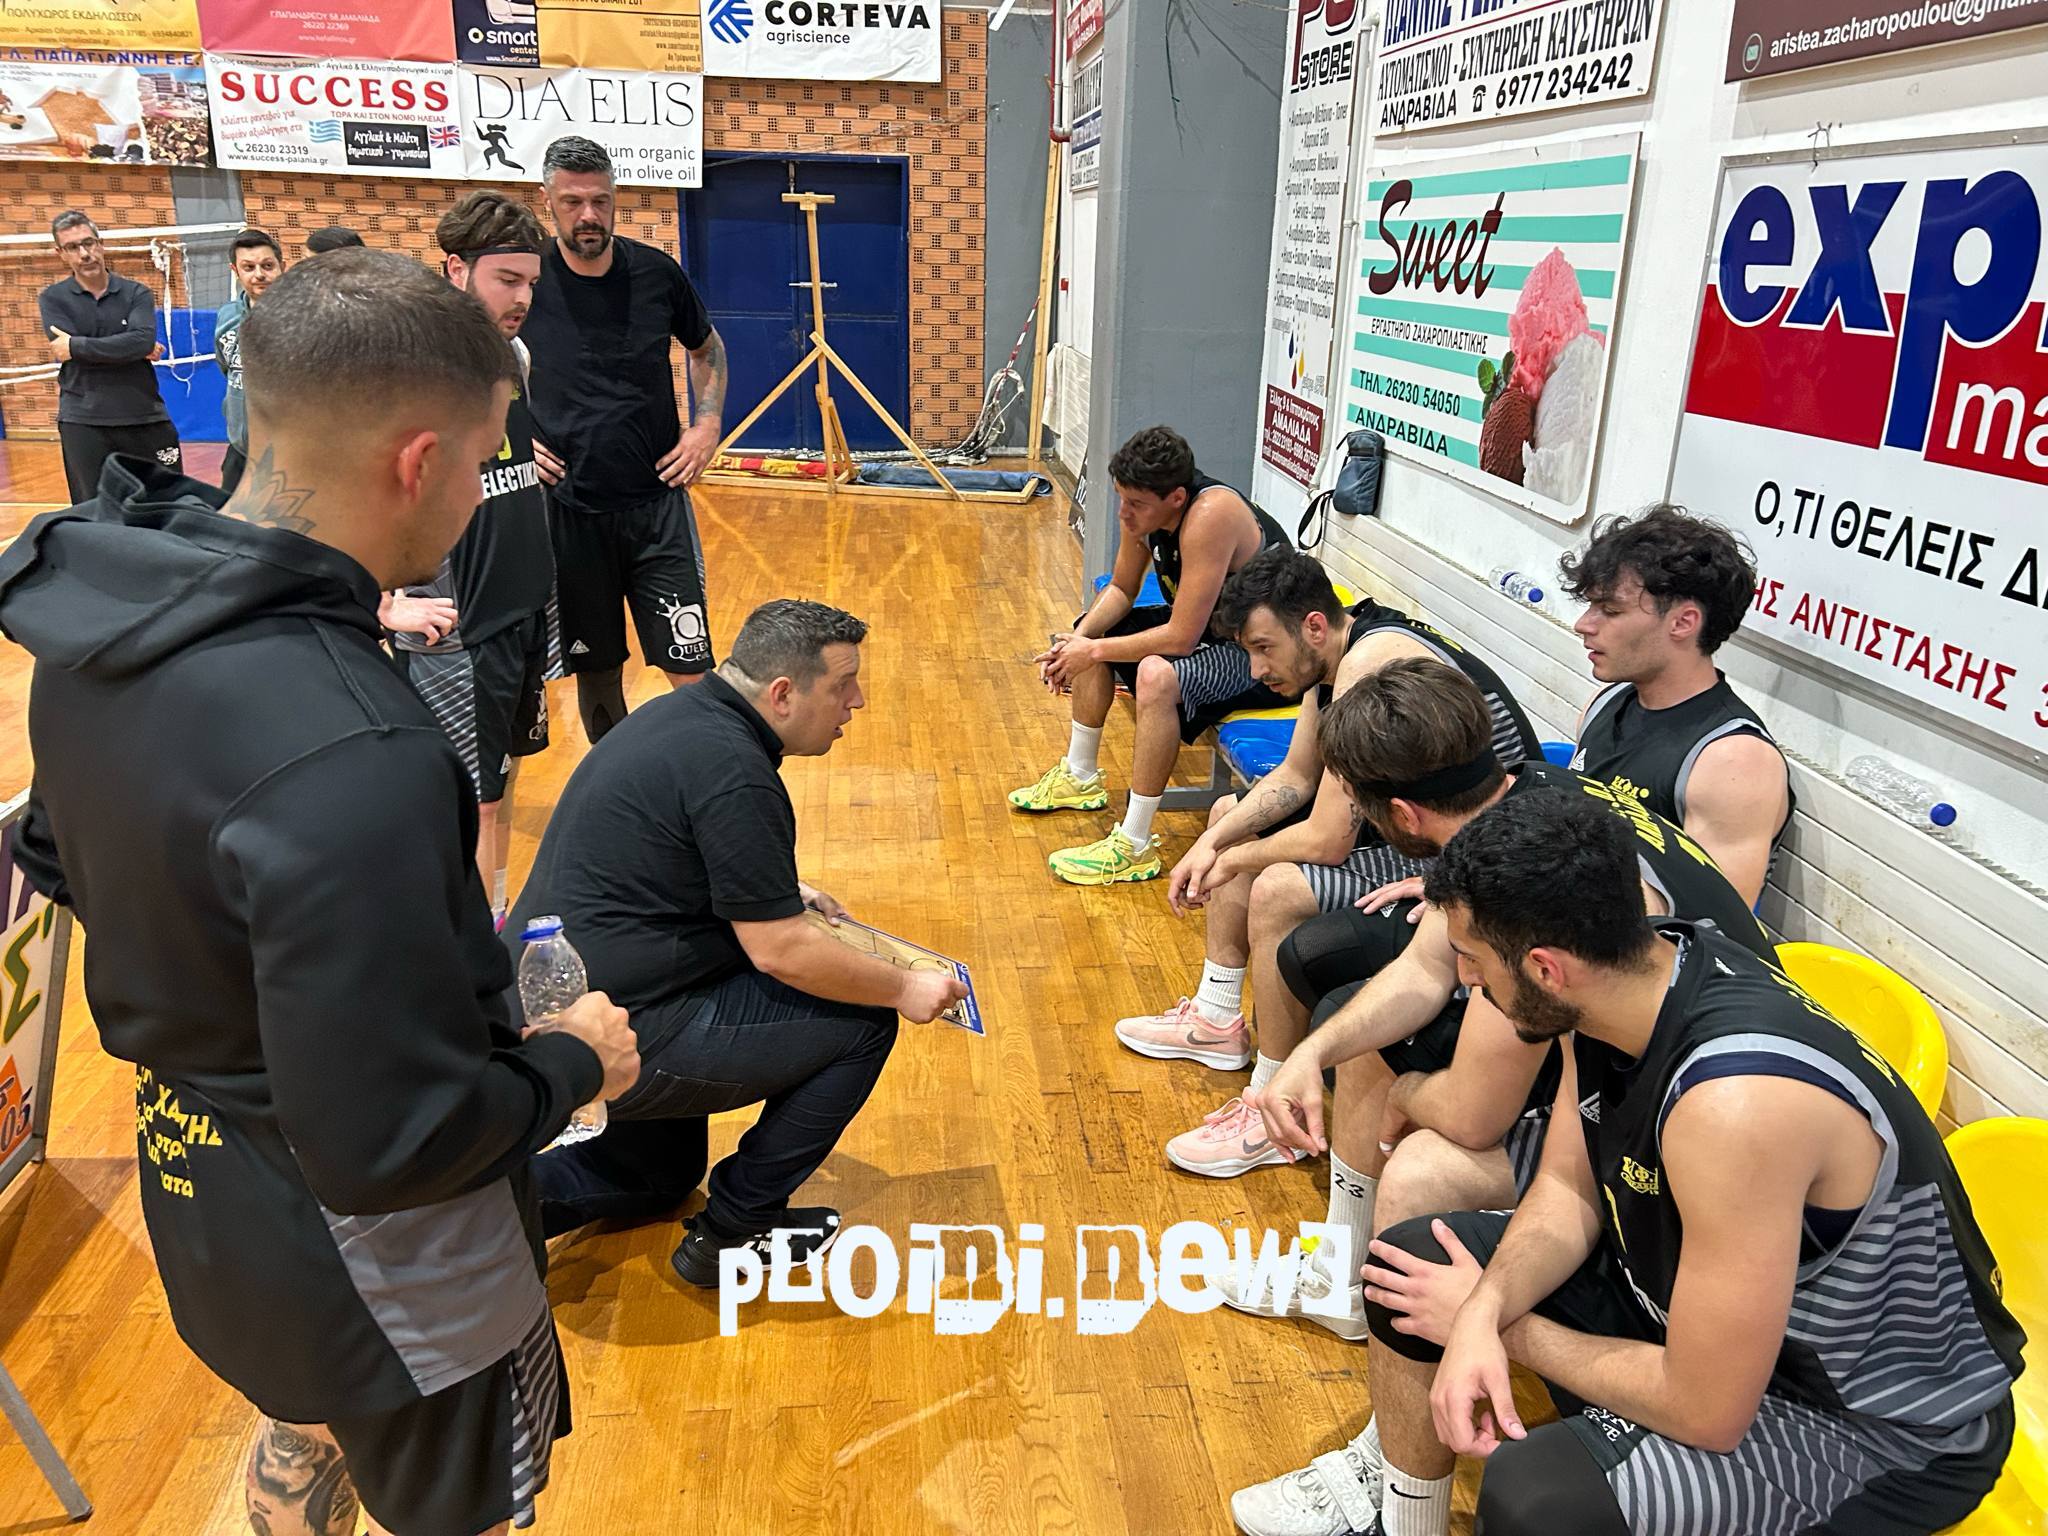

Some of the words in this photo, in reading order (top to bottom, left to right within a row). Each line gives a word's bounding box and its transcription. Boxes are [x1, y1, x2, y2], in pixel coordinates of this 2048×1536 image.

[765, 1, 931, 30] CORTEVA
[486, 29, 537, 46] smart
[766, 29, 851, 45] agriscience
[1378, 42, 1452, 102] ΑΥΤΟΜΑΤΙΣΜΟΙ
[1459, 16, 1548, 82] ΣΥΝΤΗΡΗΣΗ
[1545, 0, 1654, 62] ΚΑΥΣΤΗΡΩΝ
[34, 49, 159, 65] ΠΑΠΑΓΙΑΝΝΗ
[1299, 40, 1354, 91] STORE
[220, 71, 449, 112] SUCCESS
[472, 74, 575, 122] DIA
[586, 78, 694, 127] ELIS
[1379, 88, 1457, 128] ΑΝΔΡΑΒΙΔΑ
[1495, 70, 1543, 110] 6977
[1545, 52, 1633, 101] 234242
[245, 143, 276, 155] 26230
[279, 144, 309, 155] 23319
[638, 147, 695, 163] organic
[636, 164, 673, 180] olive
[677, 166, 695, 181] oil
[1368, 179, 1505, 300] Sweet
[1371, 317, 1411, 342] ΕΡΓΑΣΤΗΡΙΟ
[1412, 323, 1489, 355] ΖΑΧΑΡΟΠΛΑΣΤΙΚΗΣ
[1359, 369, 1383, 396] ΤΗΛ.
[1385, 375, 1420, 408] 26230
[1422, 385, 1461, 417] 54050
[1271, 409, 1312, 447] ΑΜΑΛΙΑΔΑ
[1354, 406, 1449, 458] ΑΝΔΡΑΒΙΔΑ
[1831, 500, 1995, 590] ΘΕΛΕΙΣ
[1789, 592, 2018, 712] ΑΝΤΙΣΤΑΣΗΣ
[1334, 1172, 1365, 1200] 23
